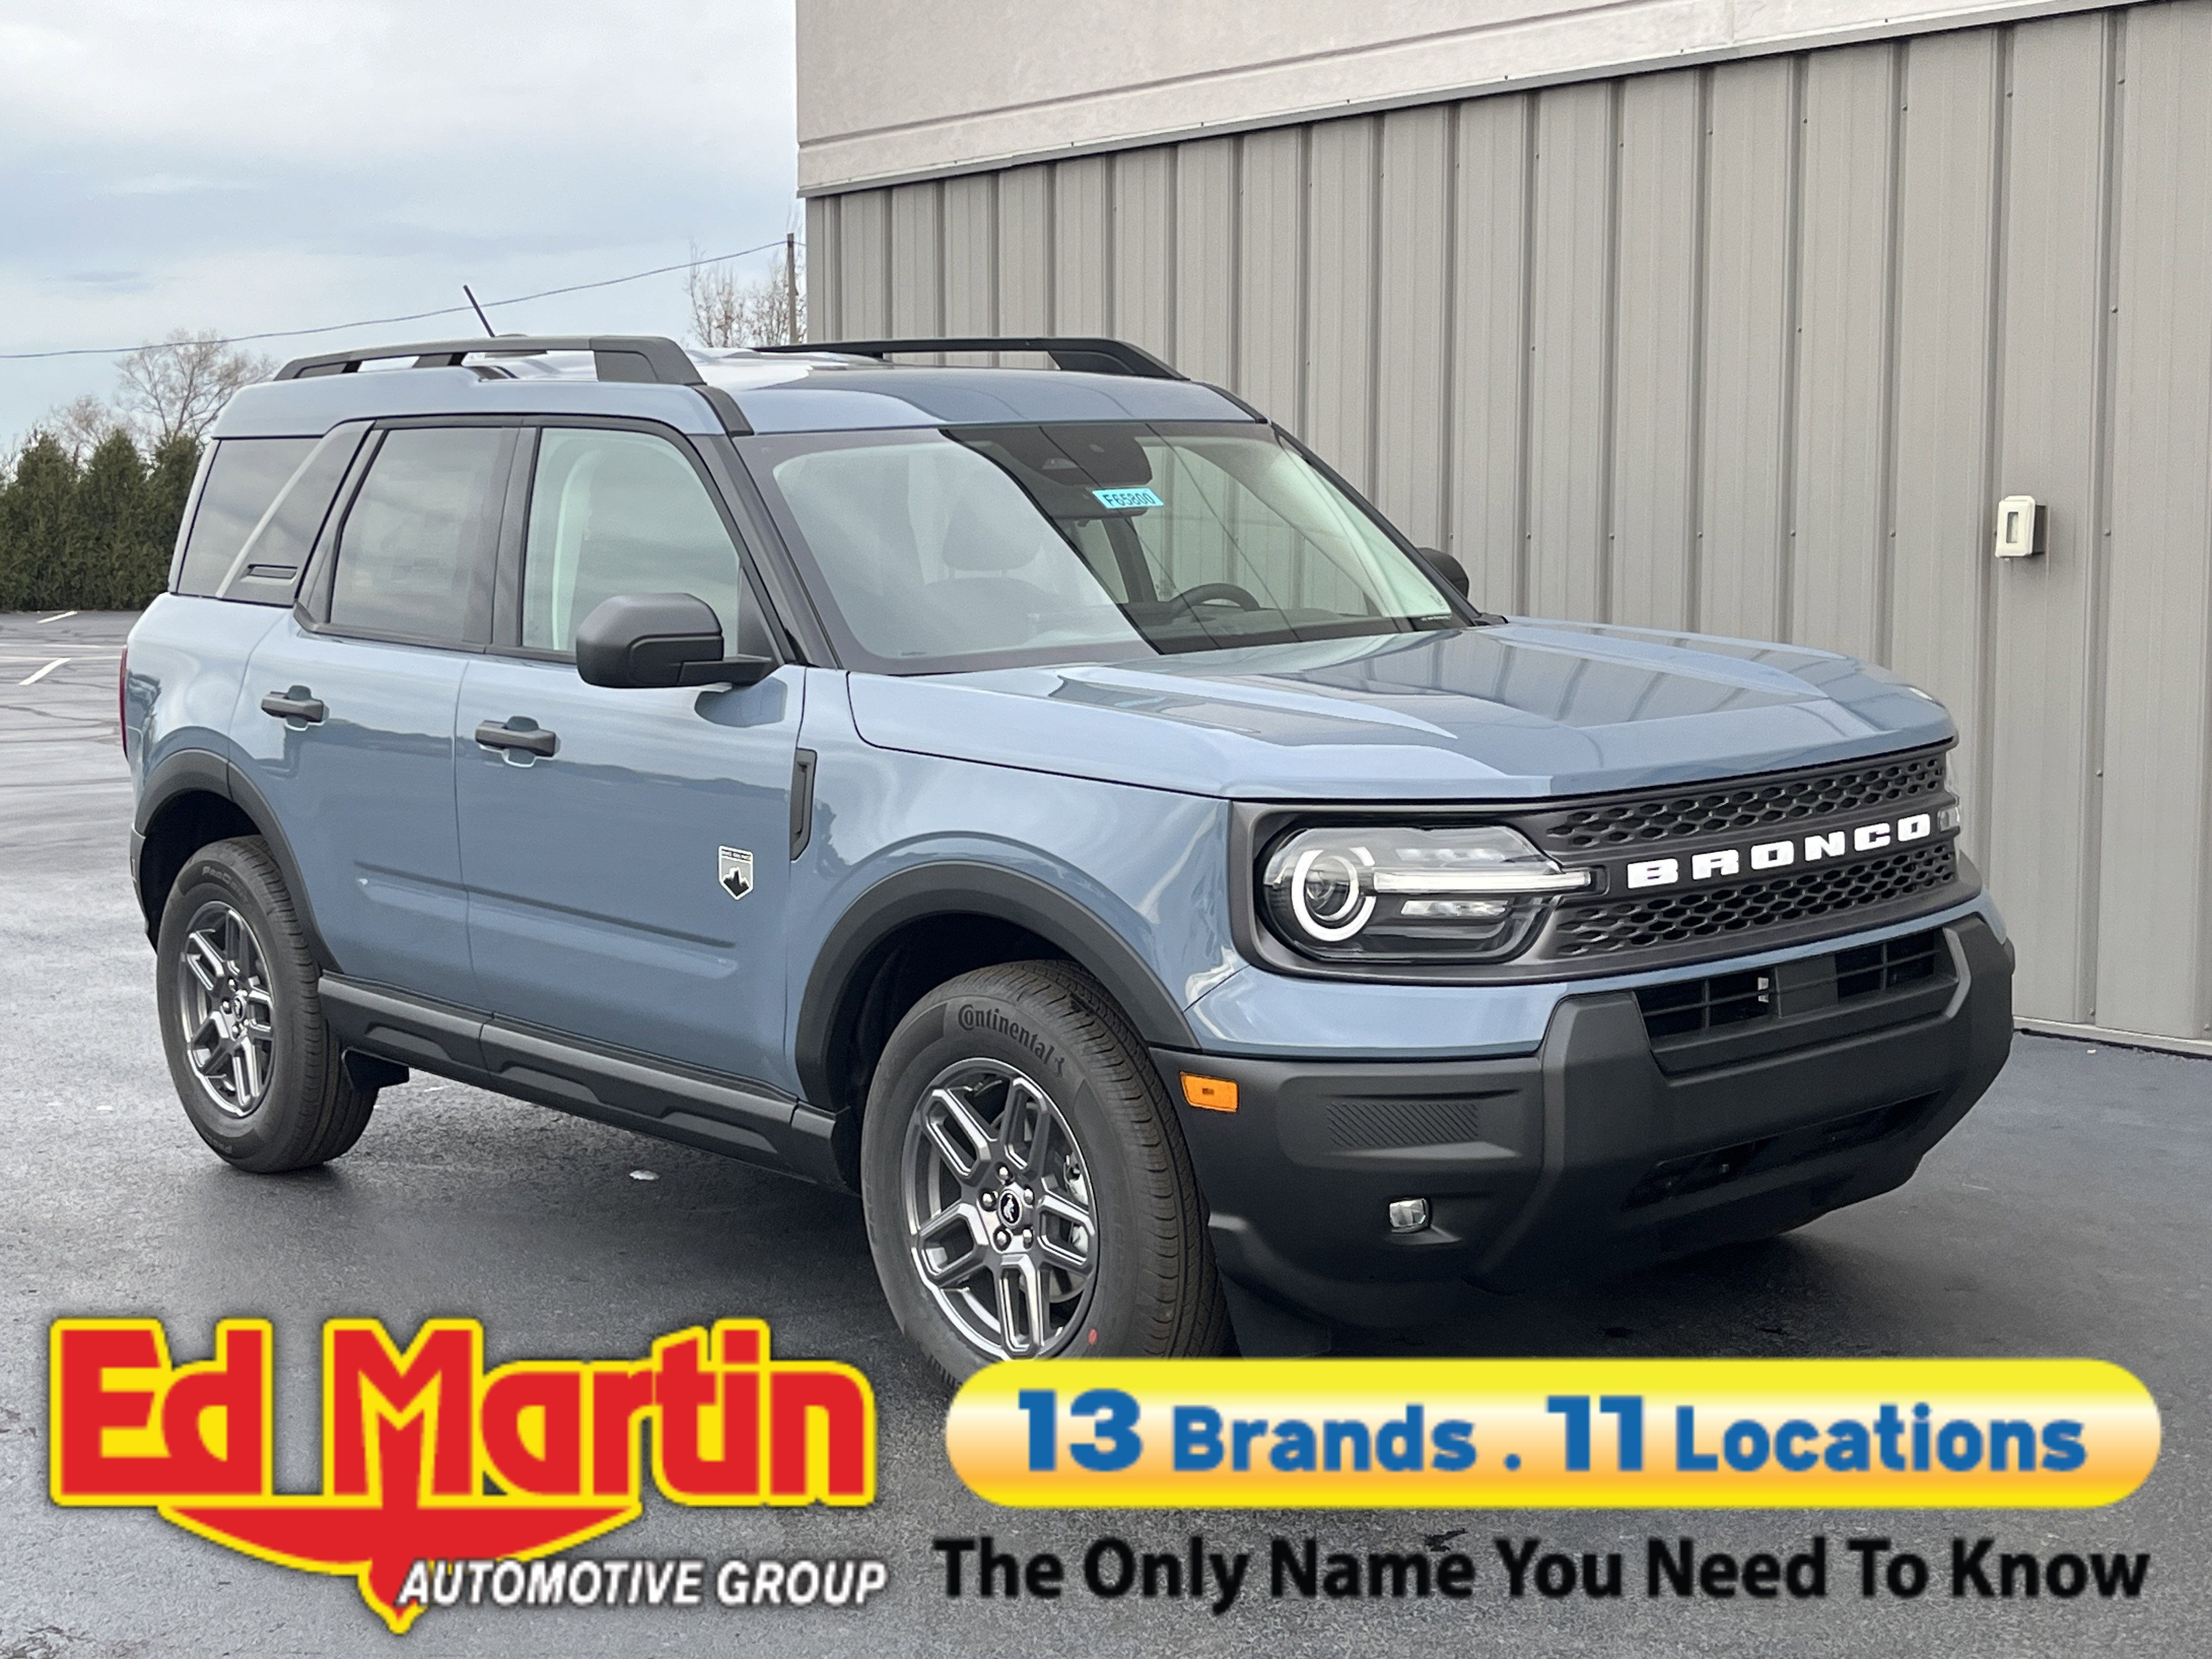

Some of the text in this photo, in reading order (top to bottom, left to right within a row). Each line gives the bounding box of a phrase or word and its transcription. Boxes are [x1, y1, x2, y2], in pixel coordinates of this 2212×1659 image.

[1103, 493, 1156, 507] F65800
[1627, 813, 1931, 889] BRONCO
[958, 1003, 1054, 1065] Continental
